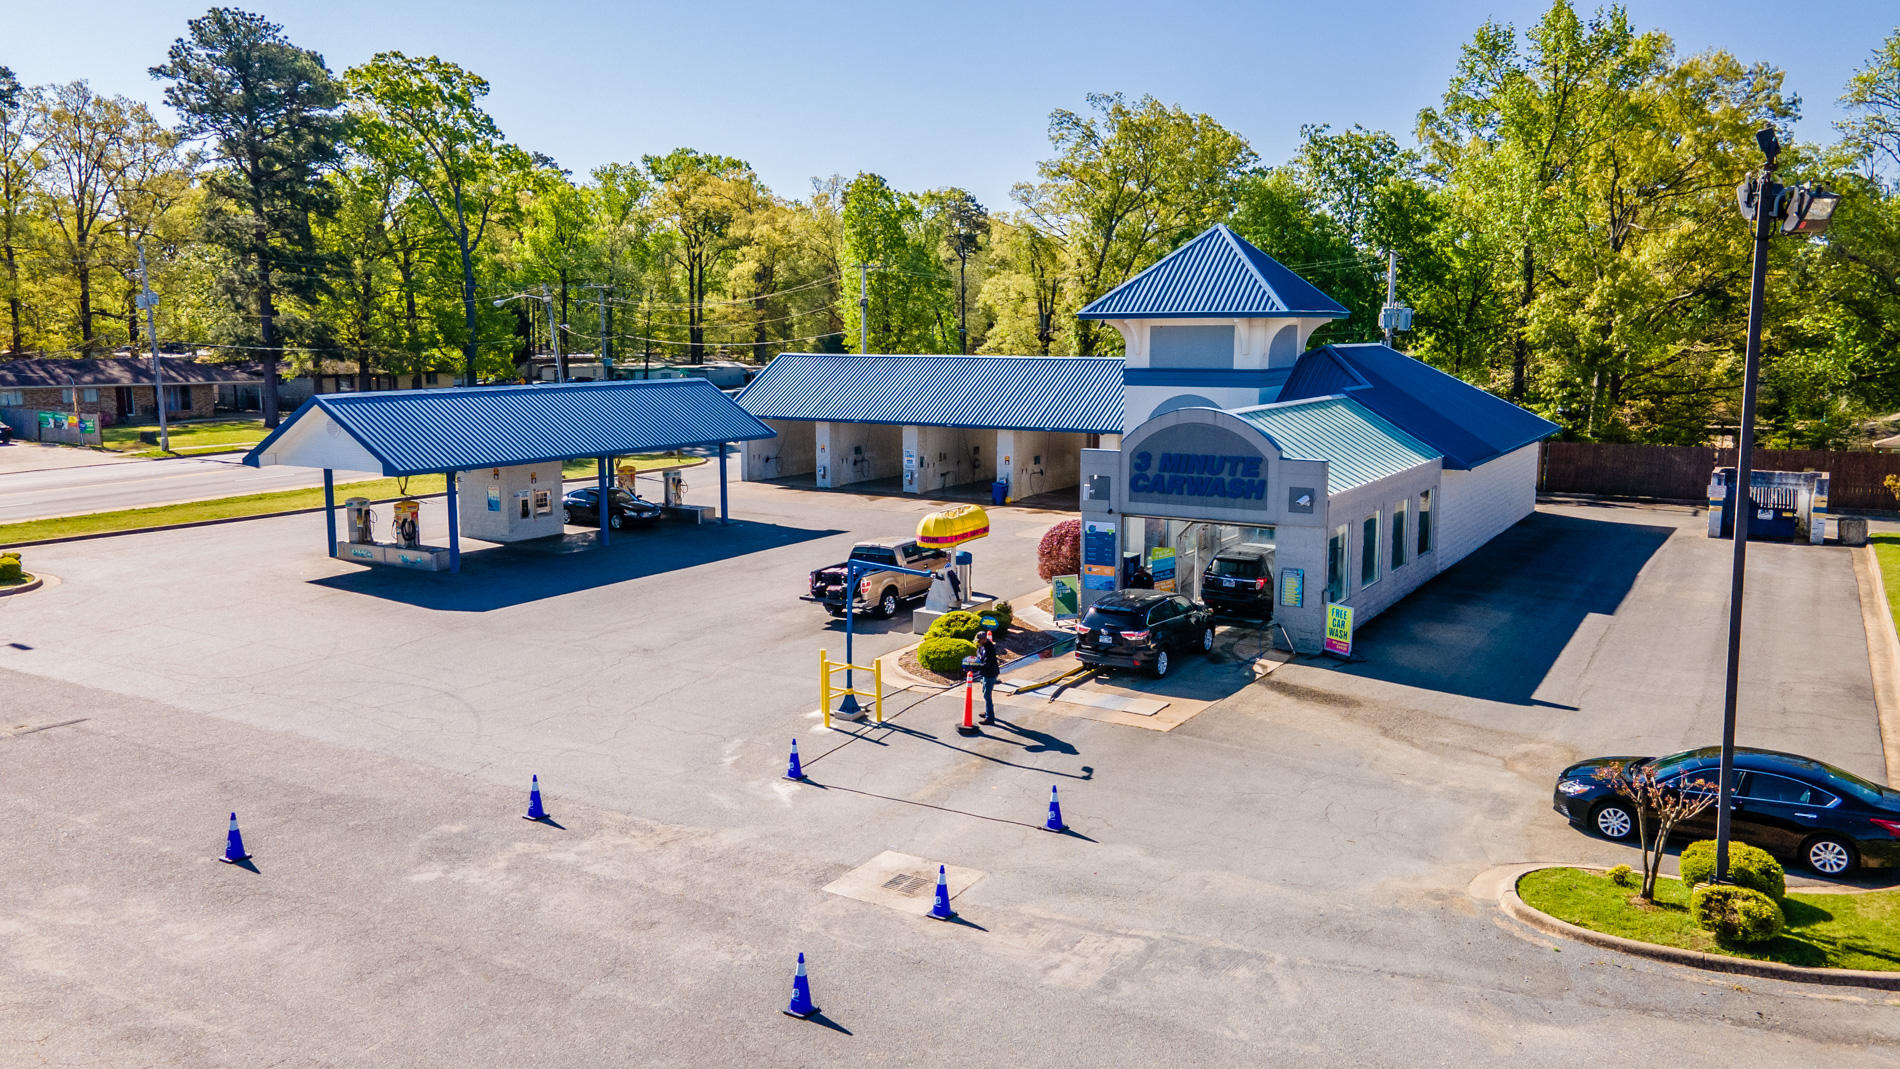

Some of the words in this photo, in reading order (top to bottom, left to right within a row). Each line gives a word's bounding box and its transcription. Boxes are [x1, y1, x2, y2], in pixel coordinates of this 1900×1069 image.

[1133, 451, 1152, 472] 3
[1158, 452, 1263, 478] MINUTE
[1130, 473, 1266, 500] CARWASH
[1331, 607, 1347, 620] FREE
[1332, 618, 1346, 630] CAR
[1329, 627, 1347, 640] WASH
